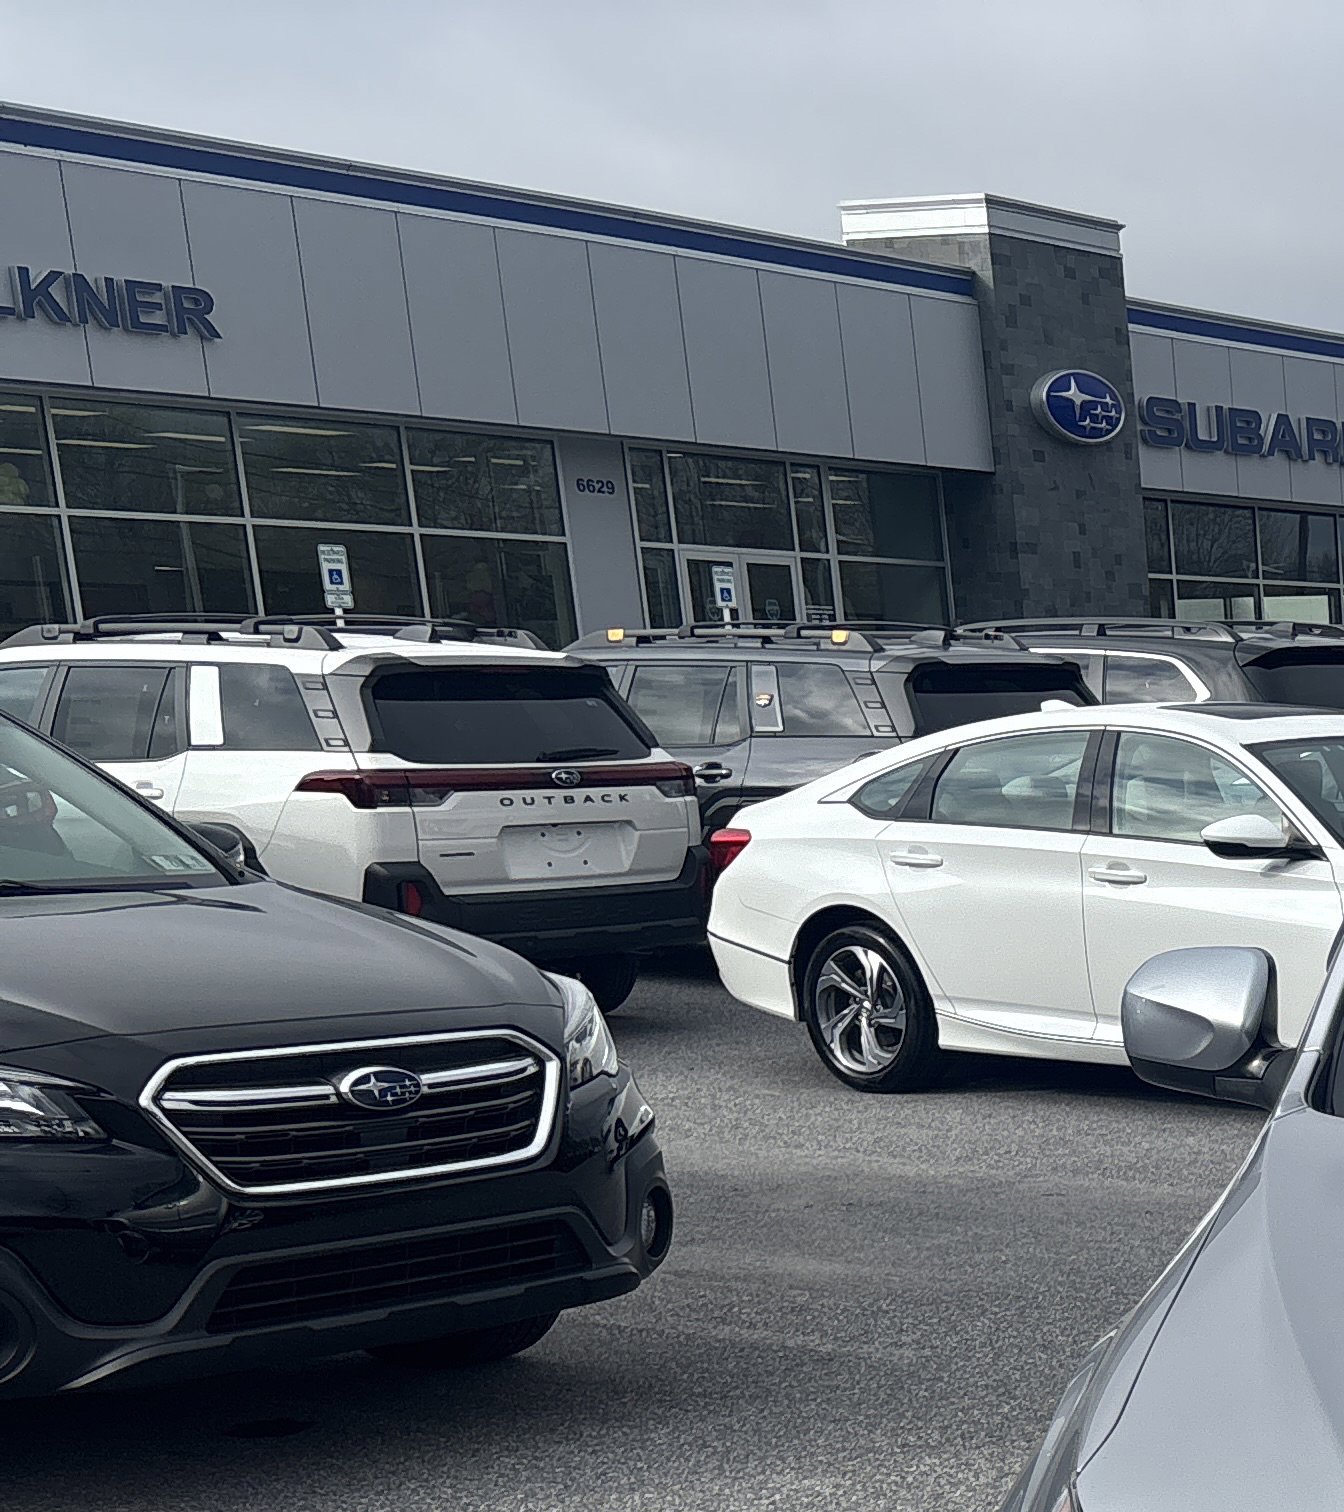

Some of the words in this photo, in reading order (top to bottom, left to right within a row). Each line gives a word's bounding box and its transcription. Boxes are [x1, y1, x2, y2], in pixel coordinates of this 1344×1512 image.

[0, 265, 223, 340] KNER
[576, 478, 616, 495] 6629
[499, 793, 630, 807] OUTBACK
